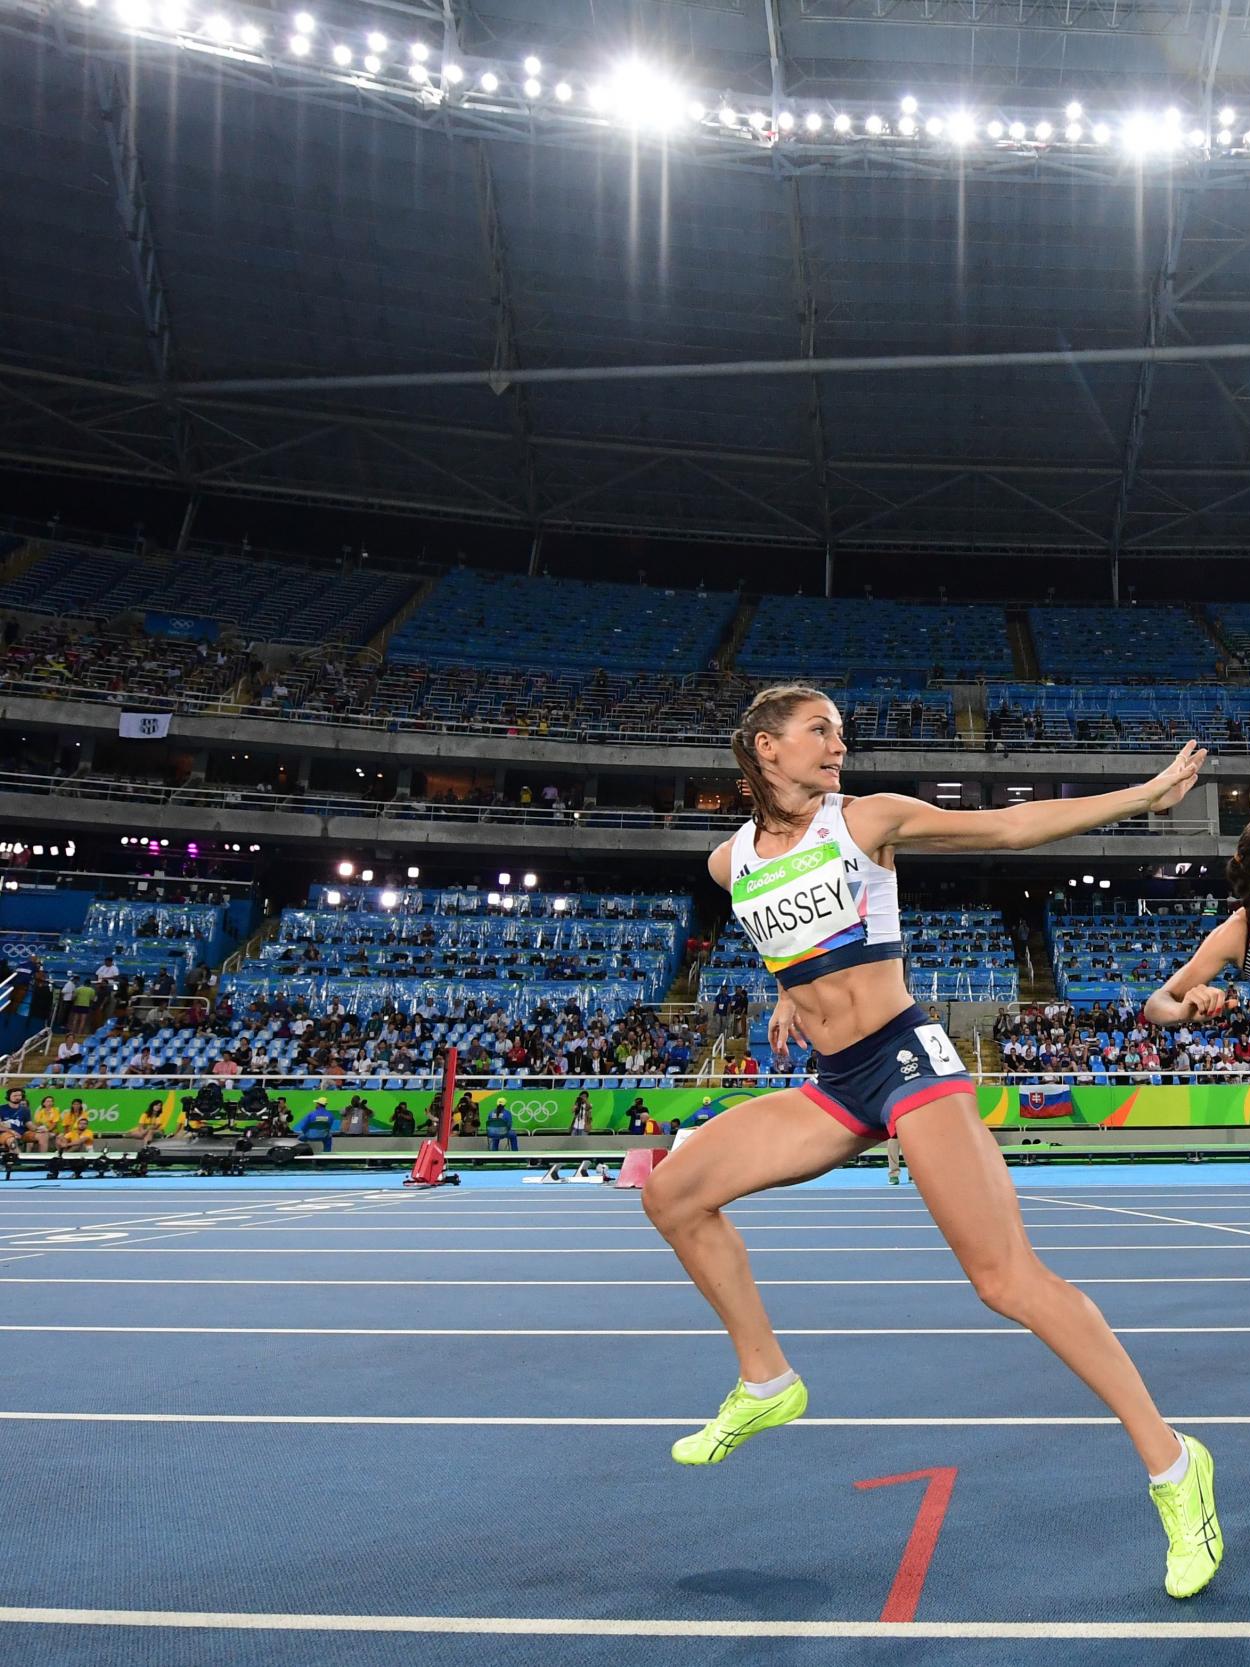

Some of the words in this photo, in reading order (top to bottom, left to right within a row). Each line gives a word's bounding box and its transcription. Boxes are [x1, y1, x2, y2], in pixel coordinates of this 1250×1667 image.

[746, 867, 787, 893] Rio2016
[741, 877, 846, 945] MASSEY
[930, 1035, 950, 1063] 2
